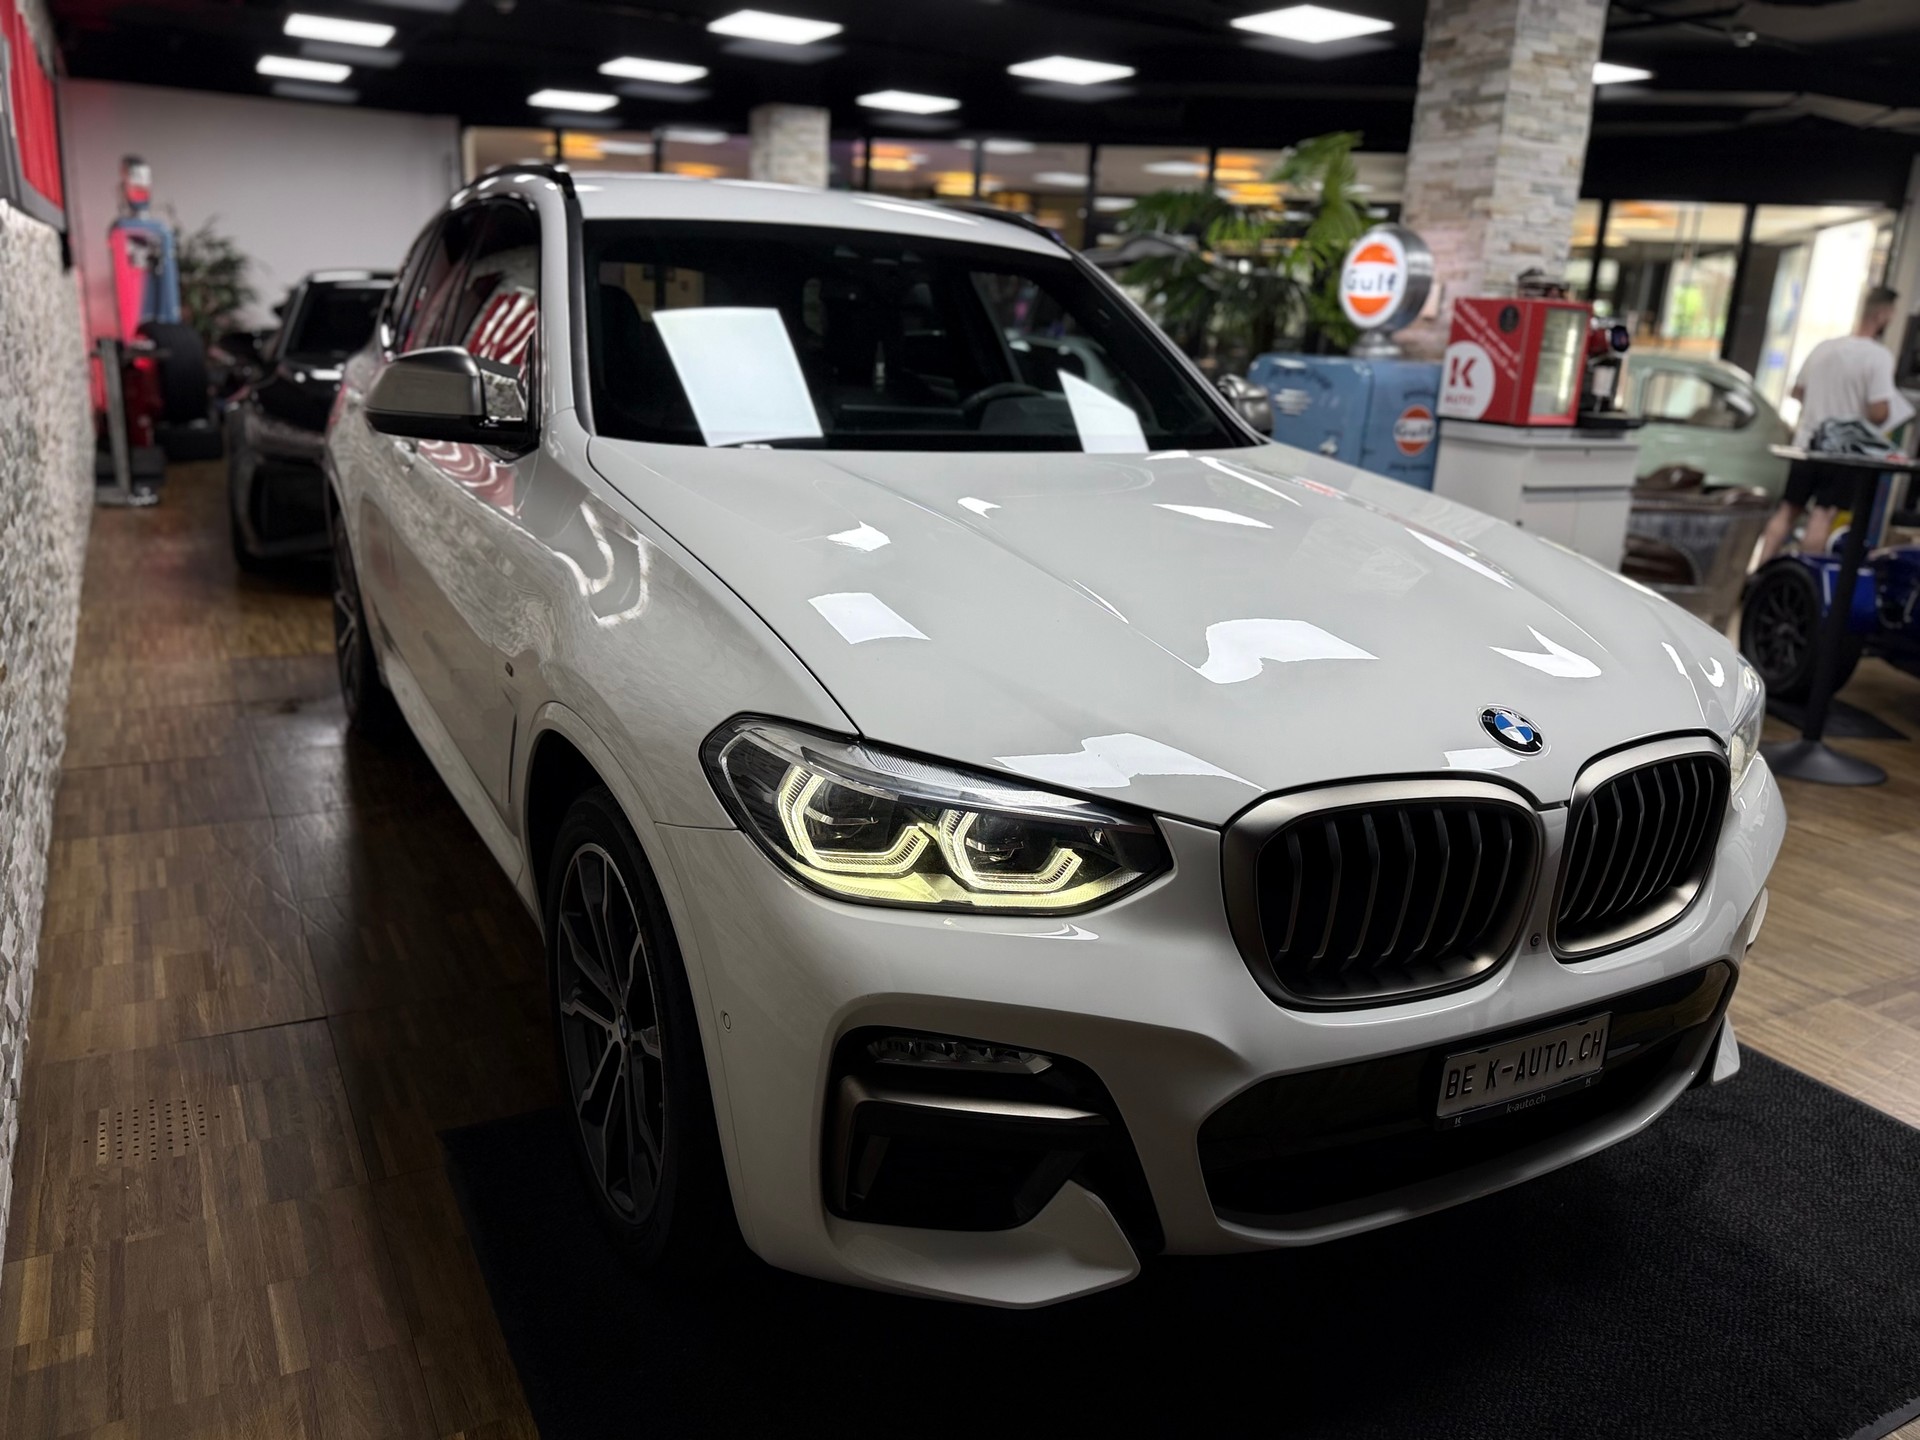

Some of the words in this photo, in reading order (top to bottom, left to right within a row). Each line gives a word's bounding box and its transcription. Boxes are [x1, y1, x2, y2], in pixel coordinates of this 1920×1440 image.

[1344, 269, 1397, 291] Gulf
[1449, 357, 1476, 389] K
[1445, 1064, 1477, 1100] BE
[1485, 1028, 1605, 1091] K-AUTO.CH
[1505, 1093, 1547, 1114] k-auto.ch
